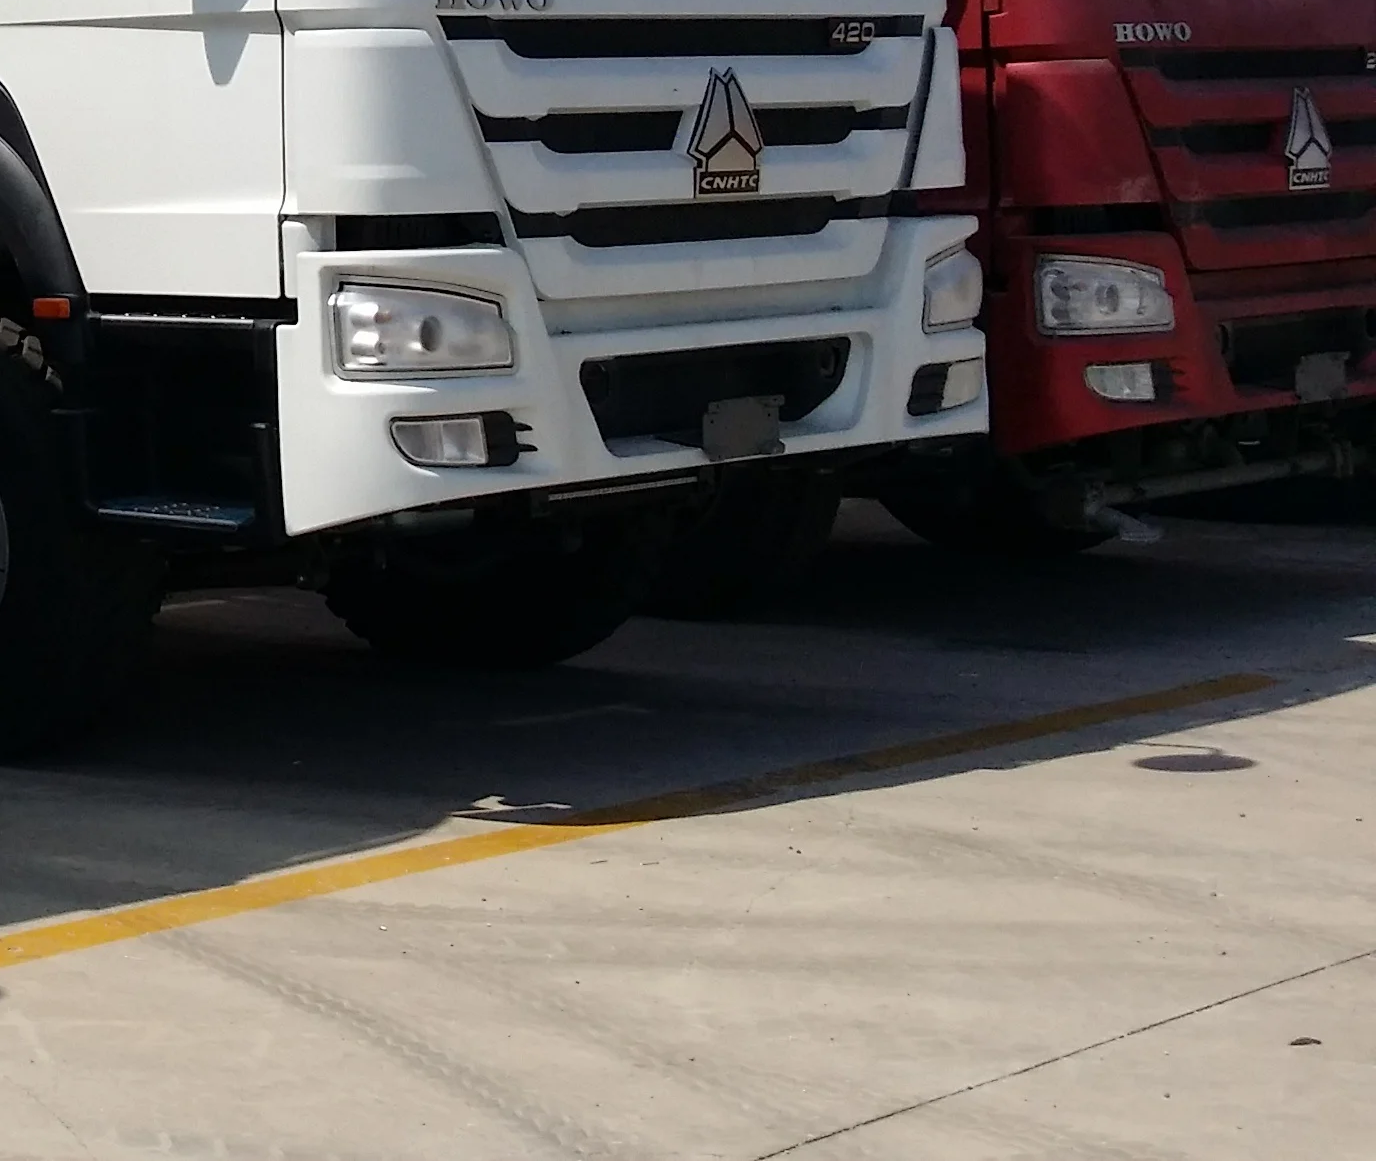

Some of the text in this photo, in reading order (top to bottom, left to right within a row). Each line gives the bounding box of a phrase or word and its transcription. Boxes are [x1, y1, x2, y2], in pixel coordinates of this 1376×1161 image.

[832, 22, 875, 42] 420
[1114, 21, 1192, 42] HOWO
[701, 175, 758, 189] CNHTC
